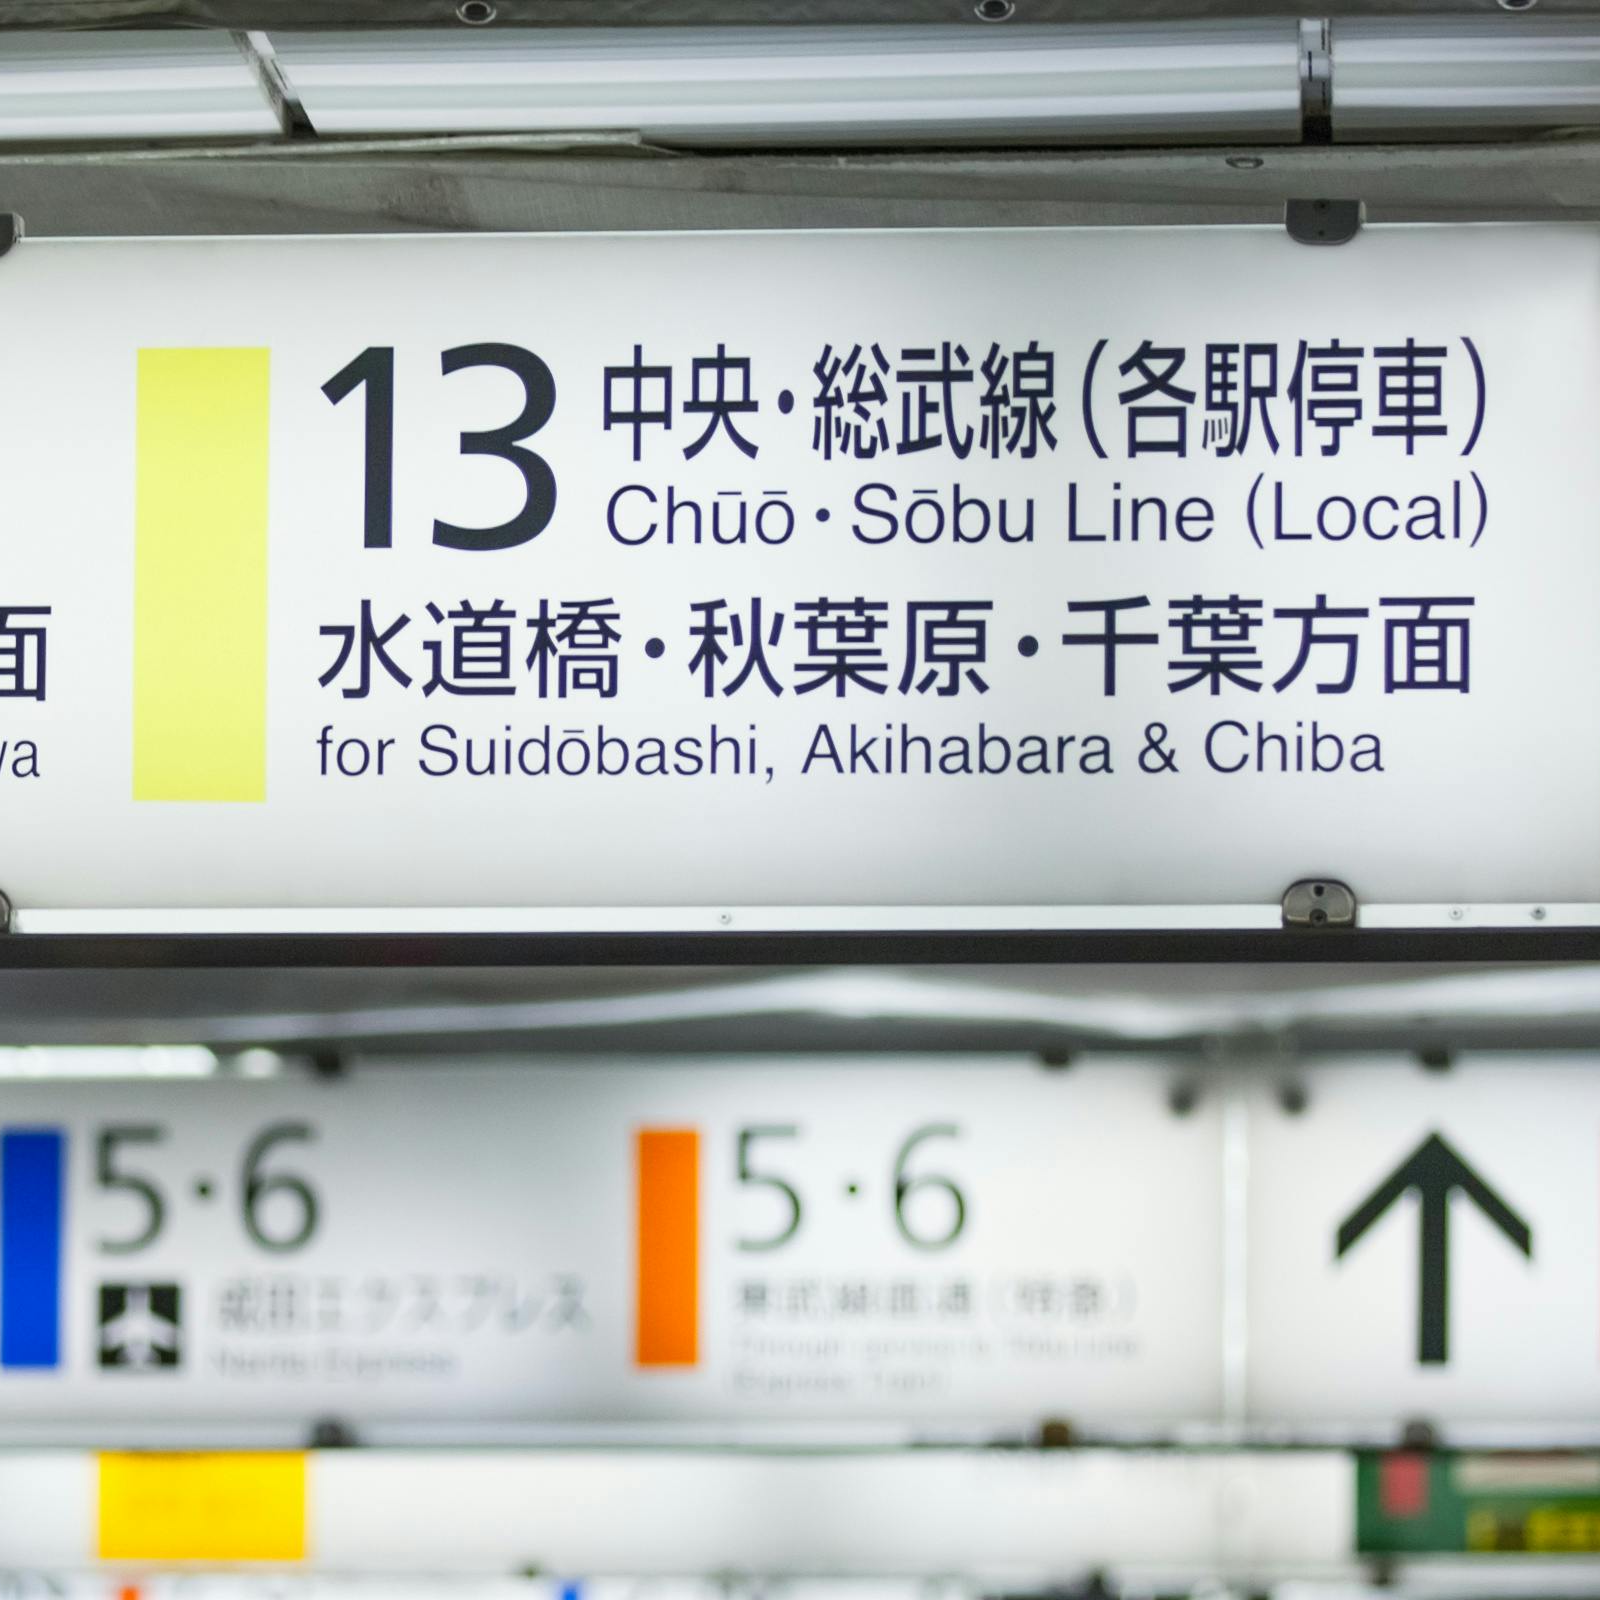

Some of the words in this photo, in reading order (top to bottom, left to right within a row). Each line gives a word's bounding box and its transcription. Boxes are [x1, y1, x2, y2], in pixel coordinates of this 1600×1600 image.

[320, 342, 557, 552] 13
[603, 336, 1487, 463] 中央・総武線（各駅停車）
[1068, 481, 1215, 543] Line
[1246, 471, 1488, 550] (Local)
[318, 593, 1476, 699] 水道橋・秋葉原・千葉方面
[316, 724, 396, 777] for
[418, 723, 774, 783] Suidōbashi,
[801, 722, 1115, 775] Akihabara
[1137, 721, 1180, 774] &
[1204, 719, 1385, 774] Chiba
